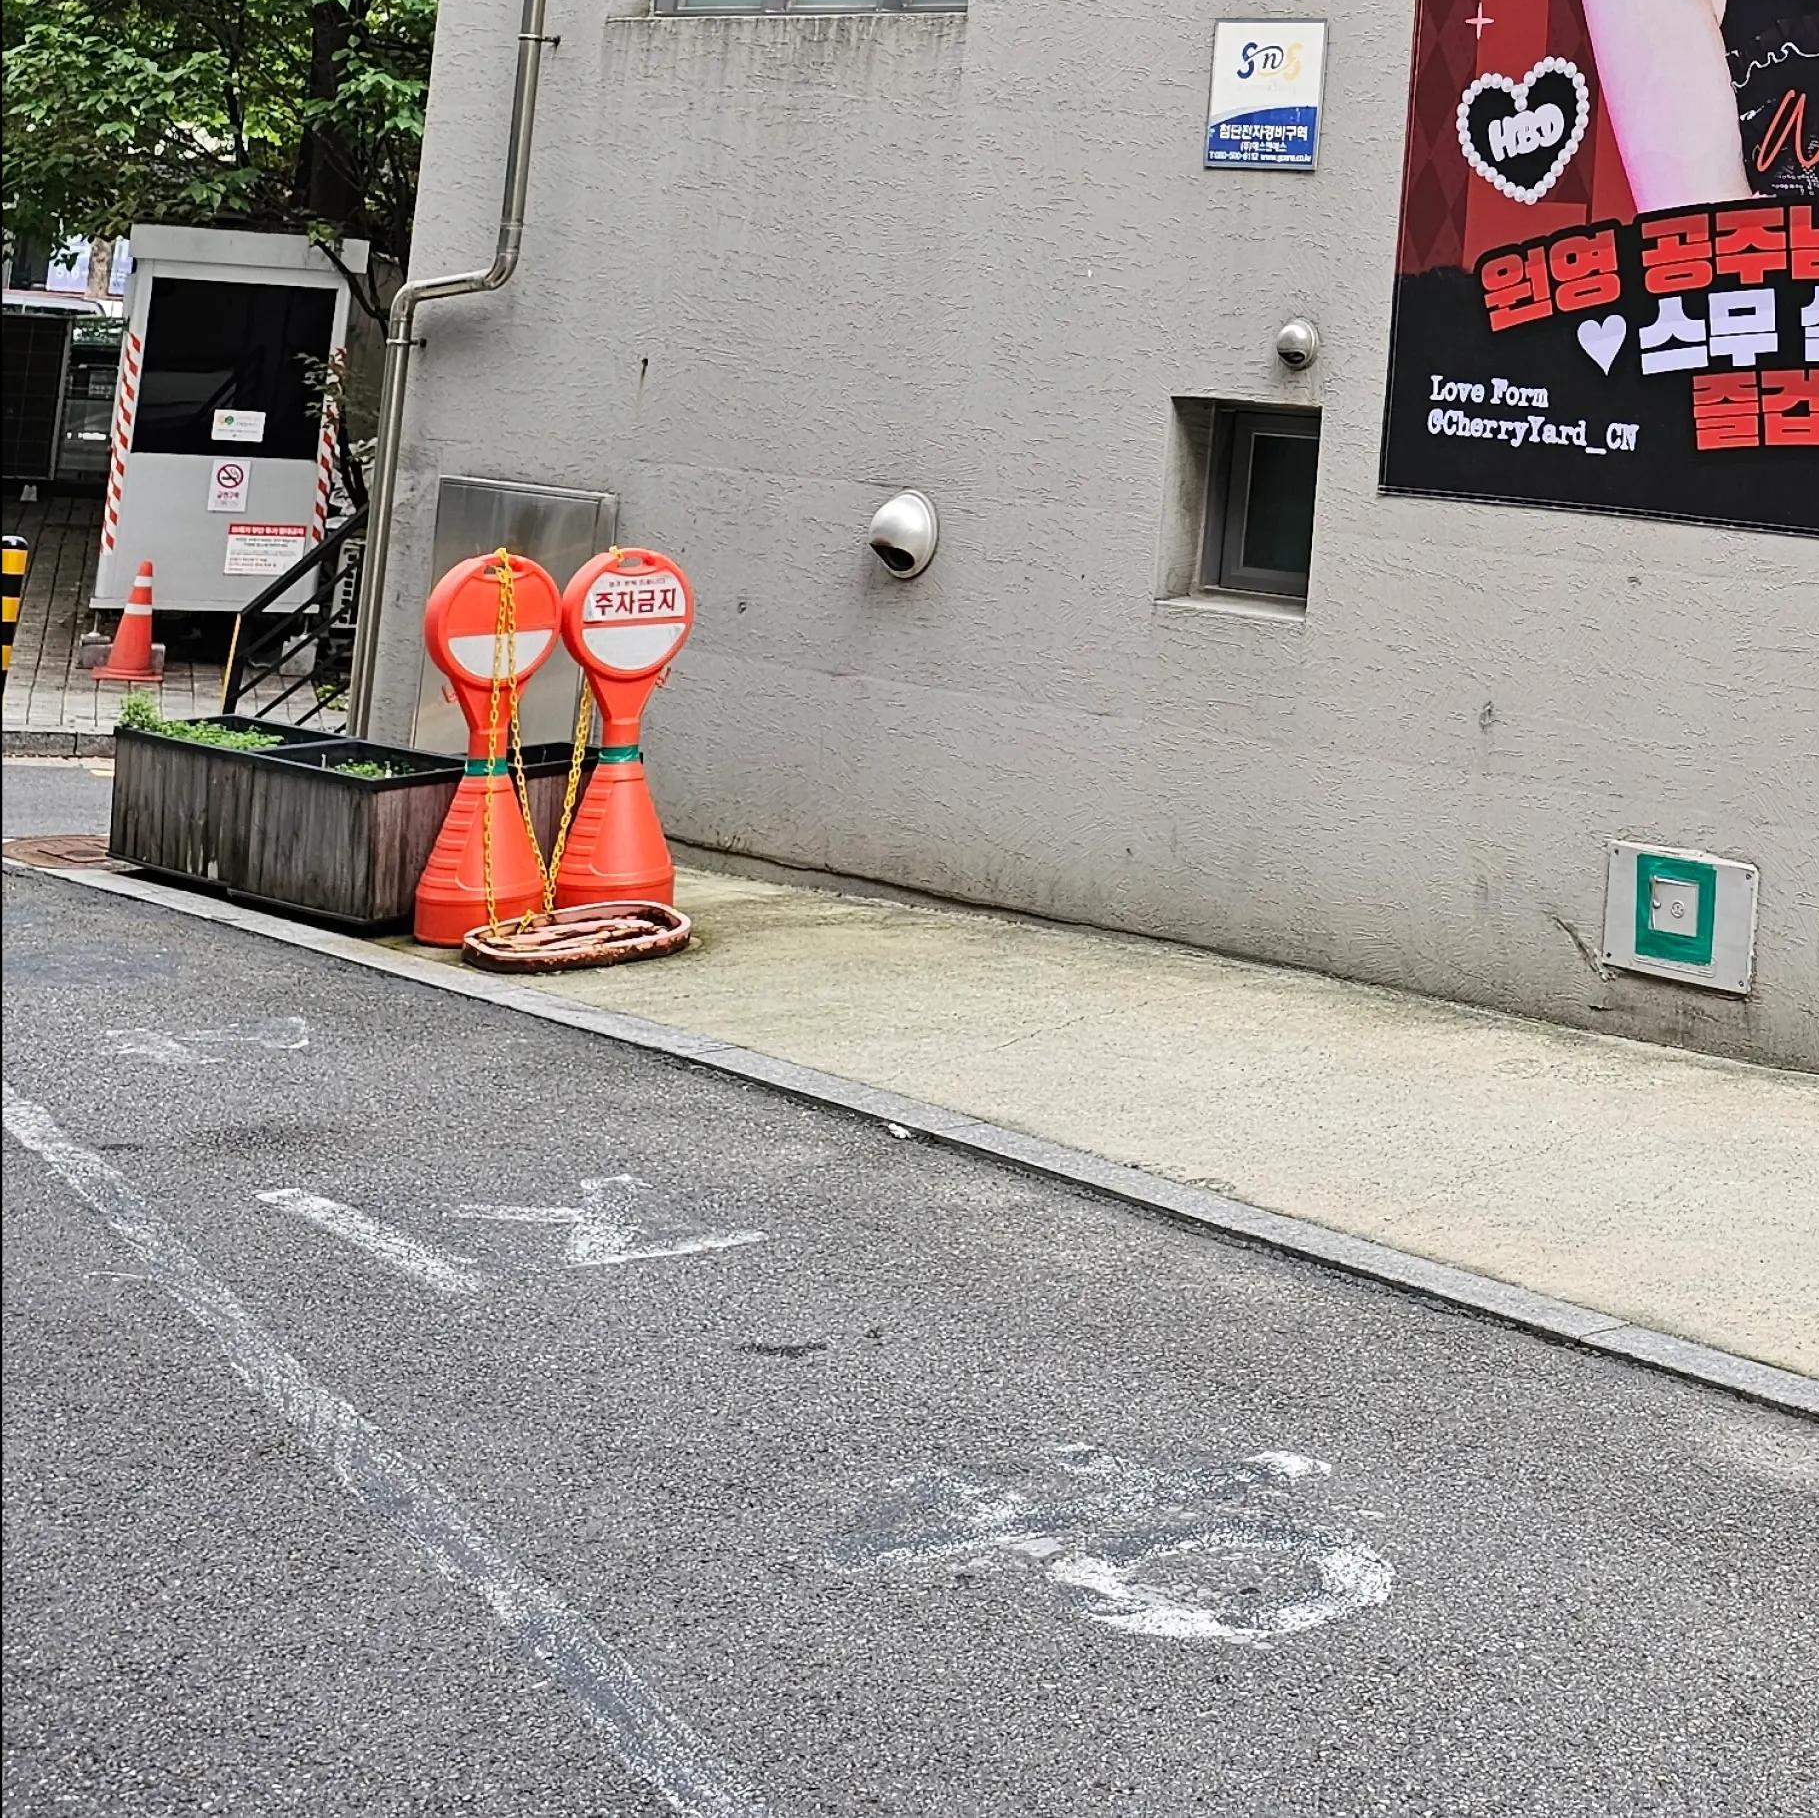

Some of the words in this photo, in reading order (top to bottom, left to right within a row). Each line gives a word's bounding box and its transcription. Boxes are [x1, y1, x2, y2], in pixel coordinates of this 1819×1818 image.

[1488, 103, 1565, 162] HBD
[1479, 229, 1621, 333] 원영
[1639, 287, 1779, 376] 스무
[1429, 375, 1485, 405] Love
[1490, 377, 1549, 409] Form
[1427, 408, 1640, 455] @CherryYard_CN
